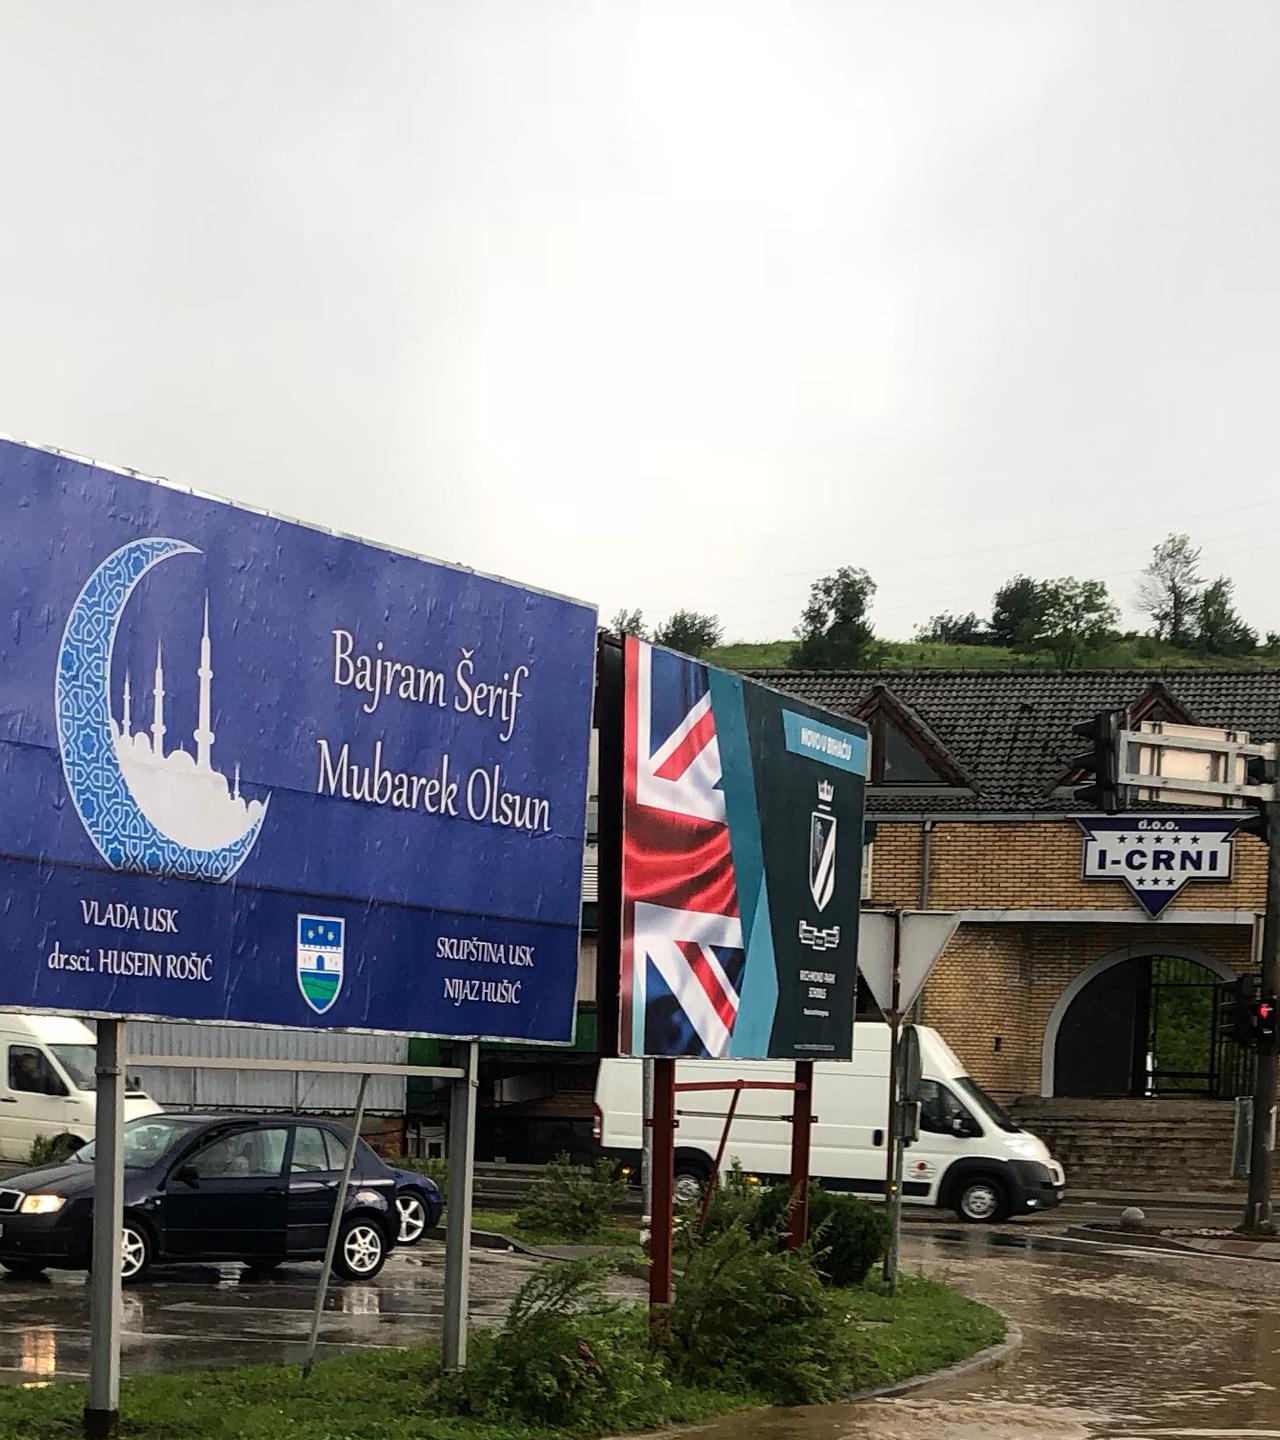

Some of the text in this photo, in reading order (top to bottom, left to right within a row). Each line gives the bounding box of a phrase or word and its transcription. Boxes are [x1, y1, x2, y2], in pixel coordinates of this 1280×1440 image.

[332, 629, 529, 742] Bajram Šerif
[317, 739, 551, 832] Mubarek Olsun
[1138, 819, 1180, 831] d.o.o.
[1097, 849, 1219, 871] I-CRNI
[80, 899, 179, 933] VLADA USK
[98, 949, 162, 977] HUSEIN
[166, 952, 213, 982] ROŠIĆ
[436, 936, 535, 967] SKUPŠTINA USK
[443, 977, 522, 1007] NIJAZ HUŠIĆ
